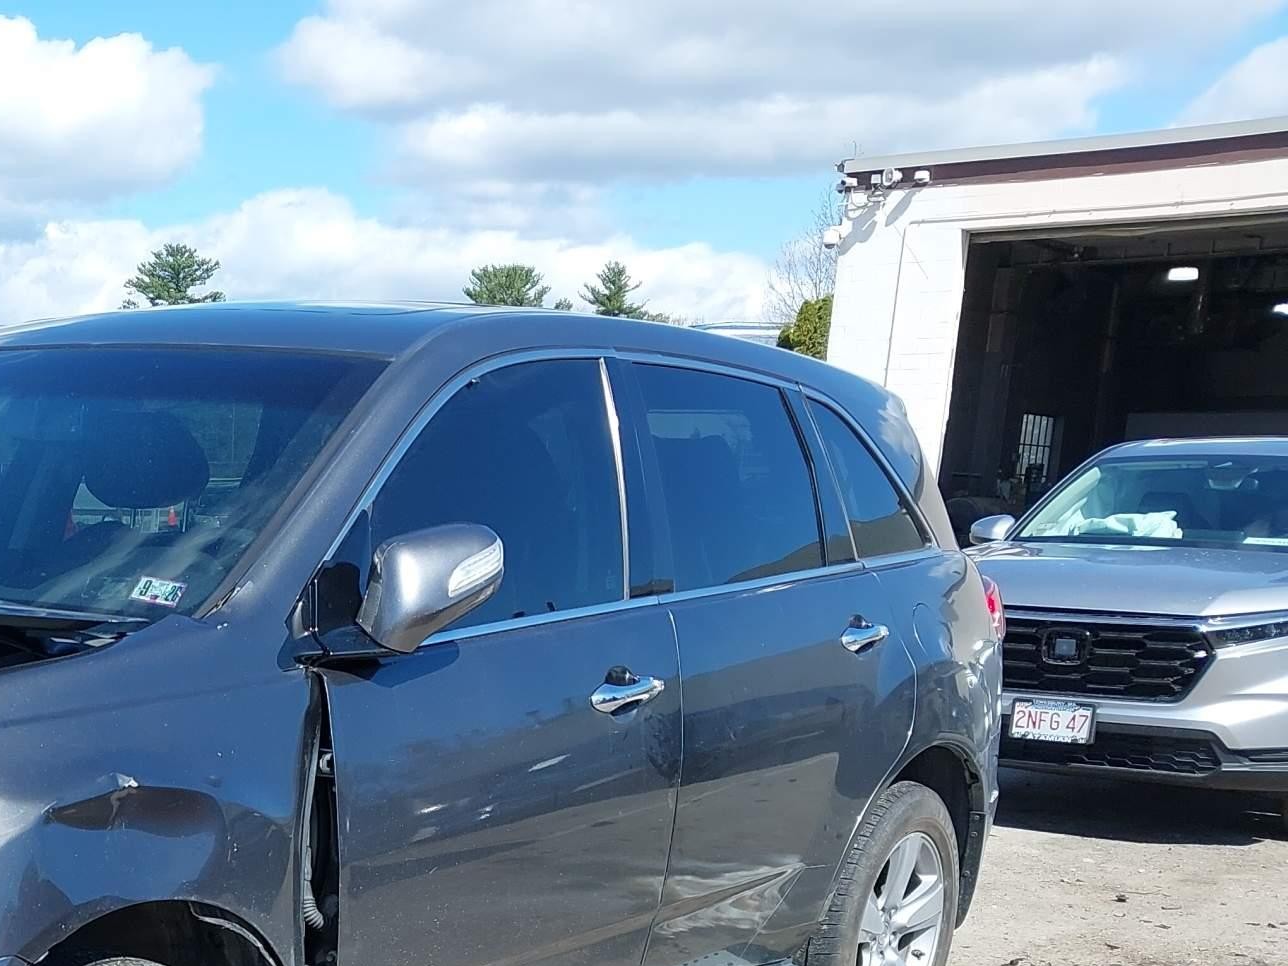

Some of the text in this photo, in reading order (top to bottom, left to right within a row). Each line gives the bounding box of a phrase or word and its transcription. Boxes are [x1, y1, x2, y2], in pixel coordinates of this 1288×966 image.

[139, 579, 153, 596] 9
[1015, 710, 1089, 733] 2NFG 47
